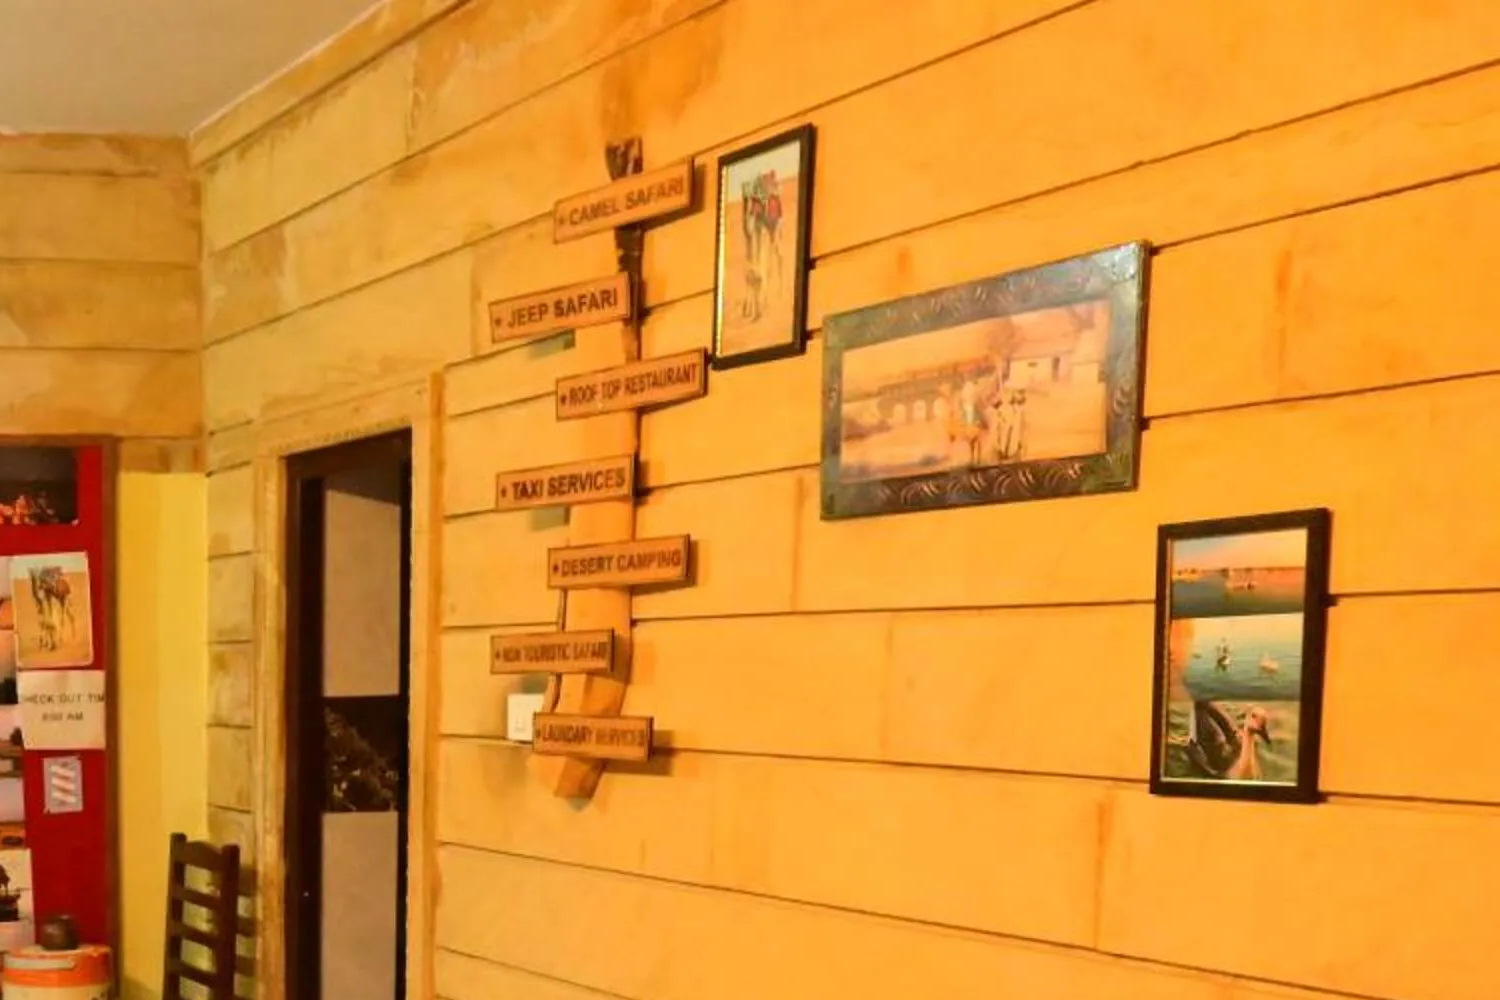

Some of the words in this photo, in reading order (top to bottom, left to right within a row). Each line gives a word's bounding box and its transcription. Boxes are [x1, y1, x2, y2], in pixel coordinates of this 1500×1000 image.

[568, 201, 620, 227] CAMEL
[625, 175, 685, 209] SAFARI
[507, 303, 549, 330] JEEP
[553, 288, 618, 319] SAFARI
[568, 383, 598, 407] ROOF
[601, 378, 621, 400] TOP
[624, 363, 697, 396] RESTAURANT
[511, 479, 544, 500] TAXI
[547, 466, 626, 497] SERVICES
[561, 556, 615, 577] DESERT
[616, 547, 682, 572] CAMPING
